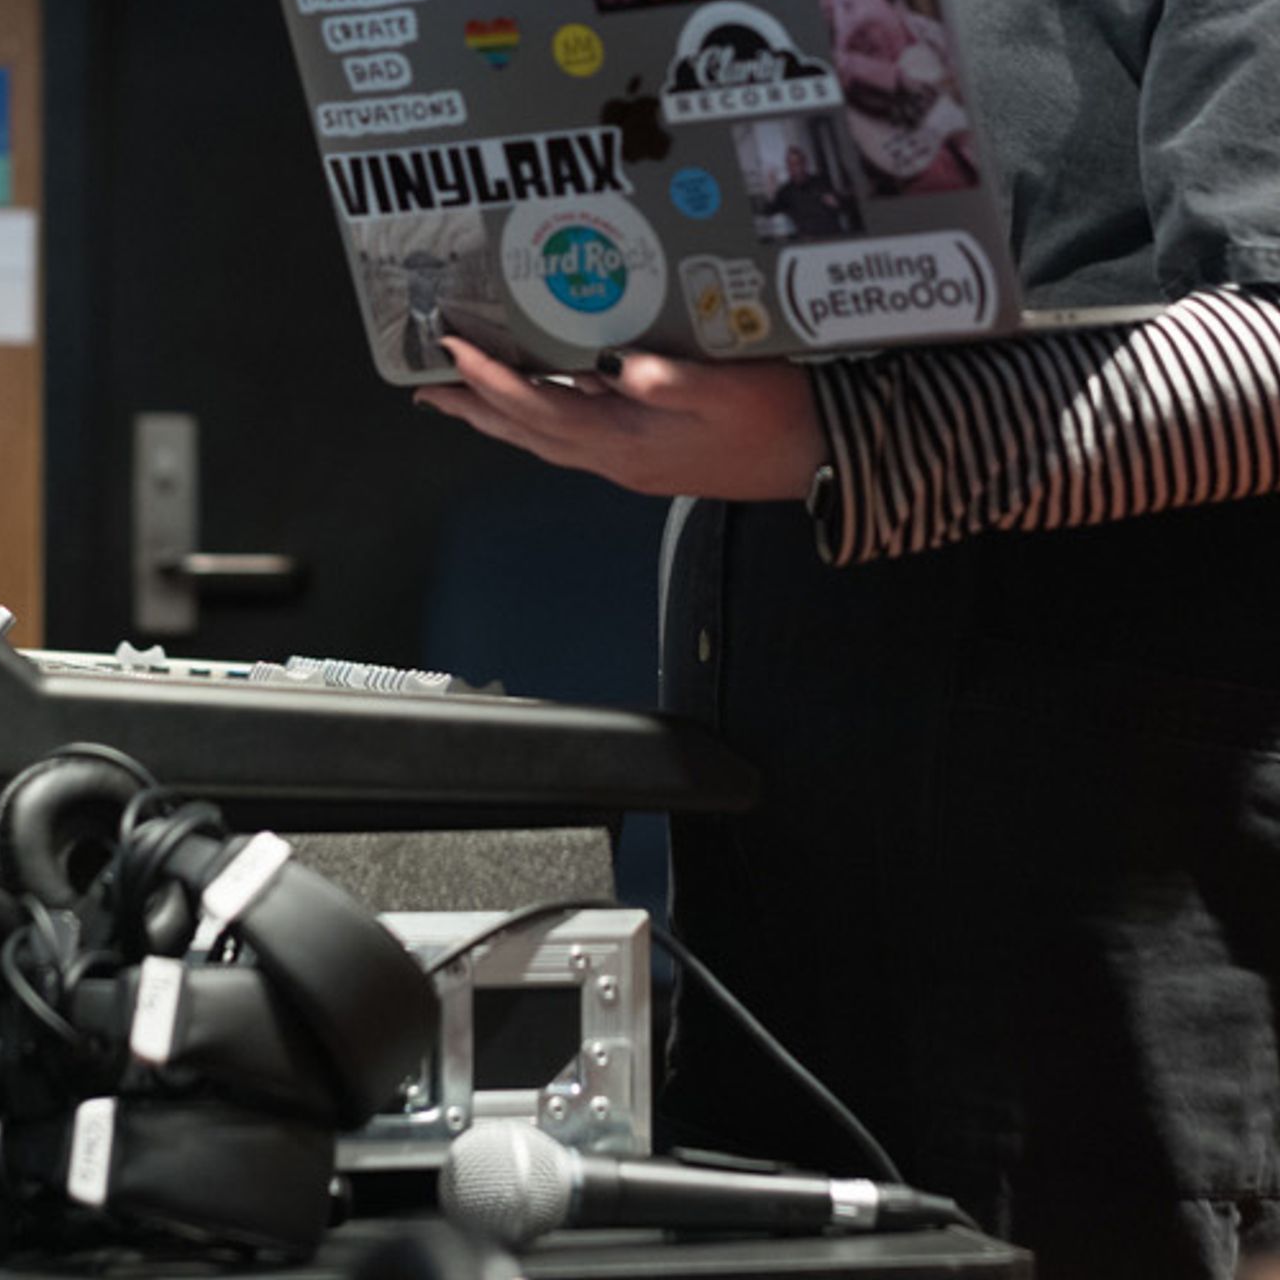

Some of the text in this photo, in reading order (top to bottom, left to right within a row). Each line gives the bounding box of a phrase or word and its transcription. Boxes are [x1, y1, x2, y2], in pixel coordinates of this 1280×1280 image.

[327, 15, 410, 43] CREATE
[351, 58, 405, 84] BAD
[323, 96, 458, 129] SITUATIONS
[677, 82, 828, 113] RECORDS
[827, 251, 939, 286] selling
